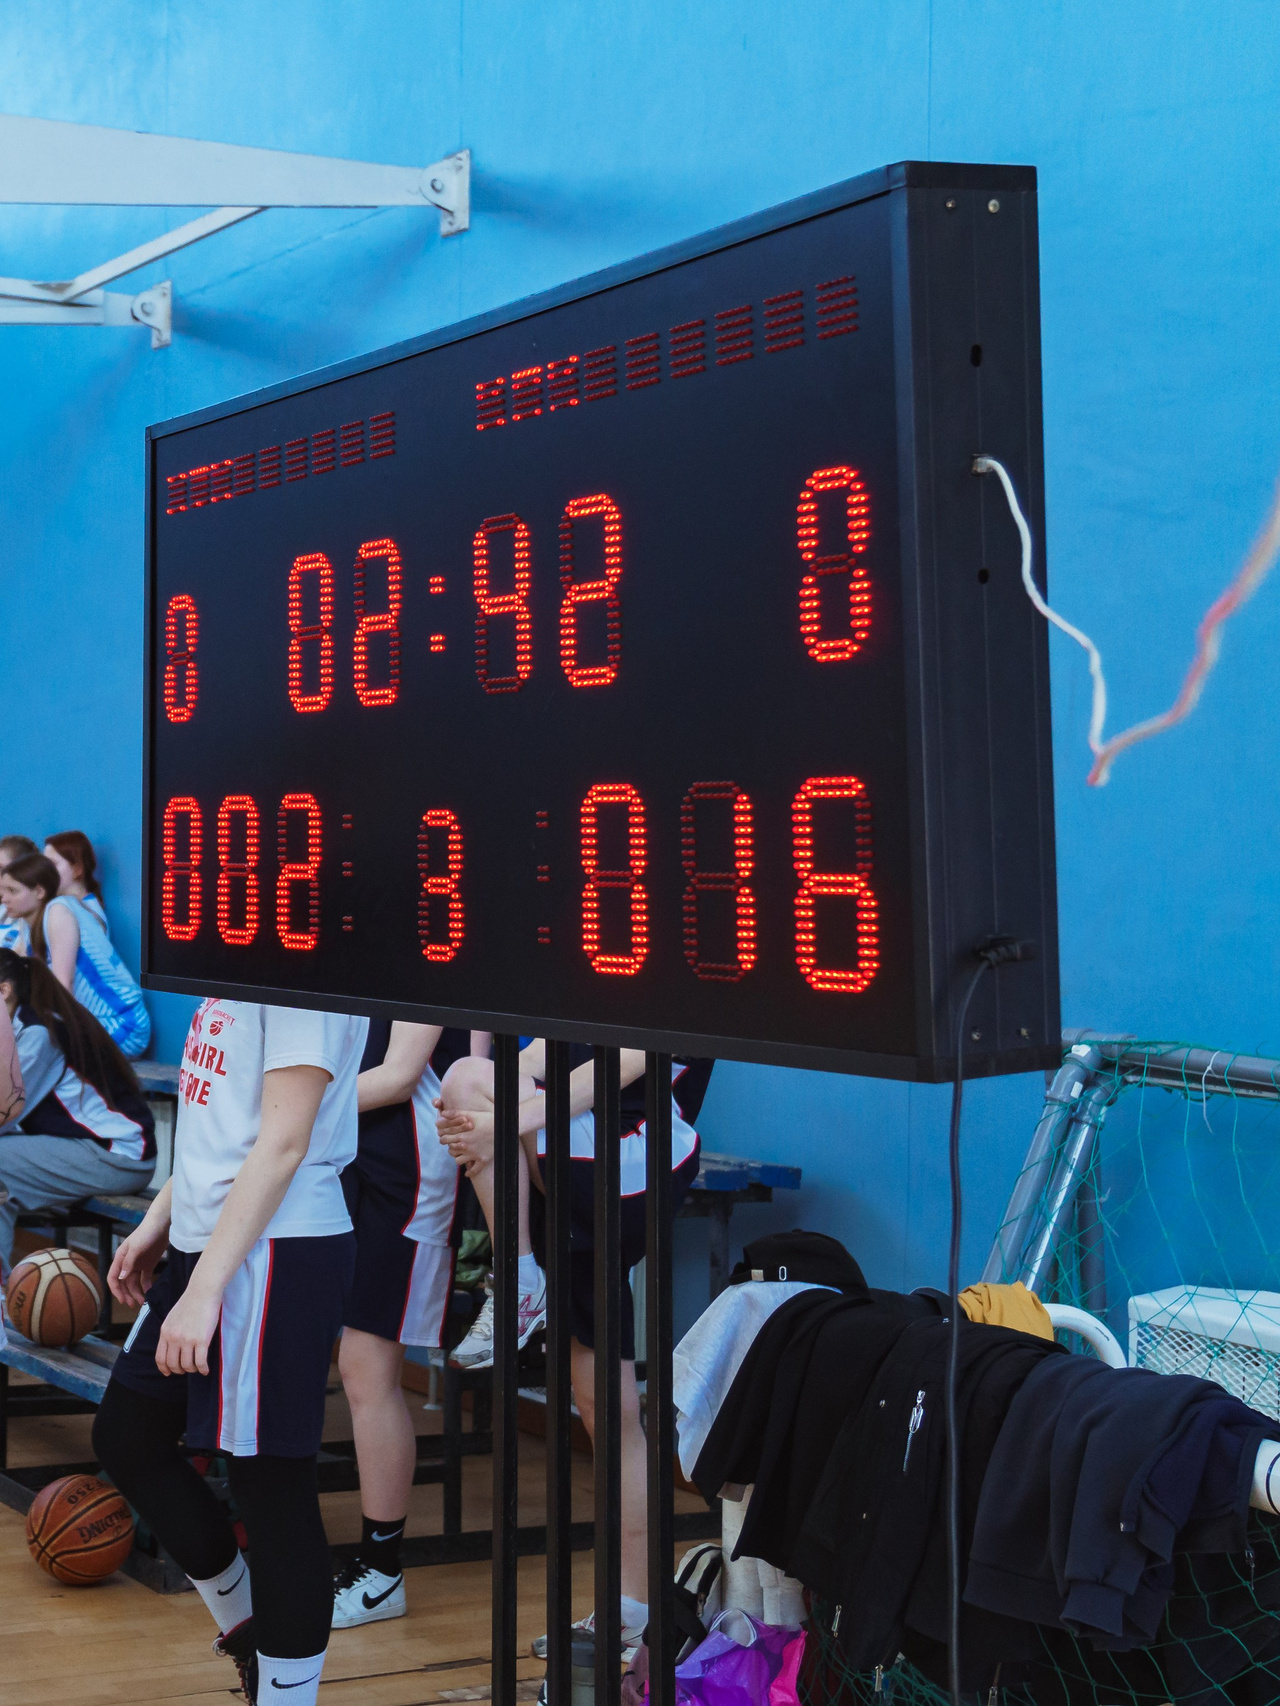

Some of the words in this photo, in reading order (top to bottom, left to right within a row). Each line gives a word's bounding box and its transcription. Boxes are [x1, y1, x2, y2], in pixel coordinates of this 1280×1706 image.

[163, 594, 199, 723] 0
[796, 464, 871, 662] 0
[421, 808, 464, 963] 3
